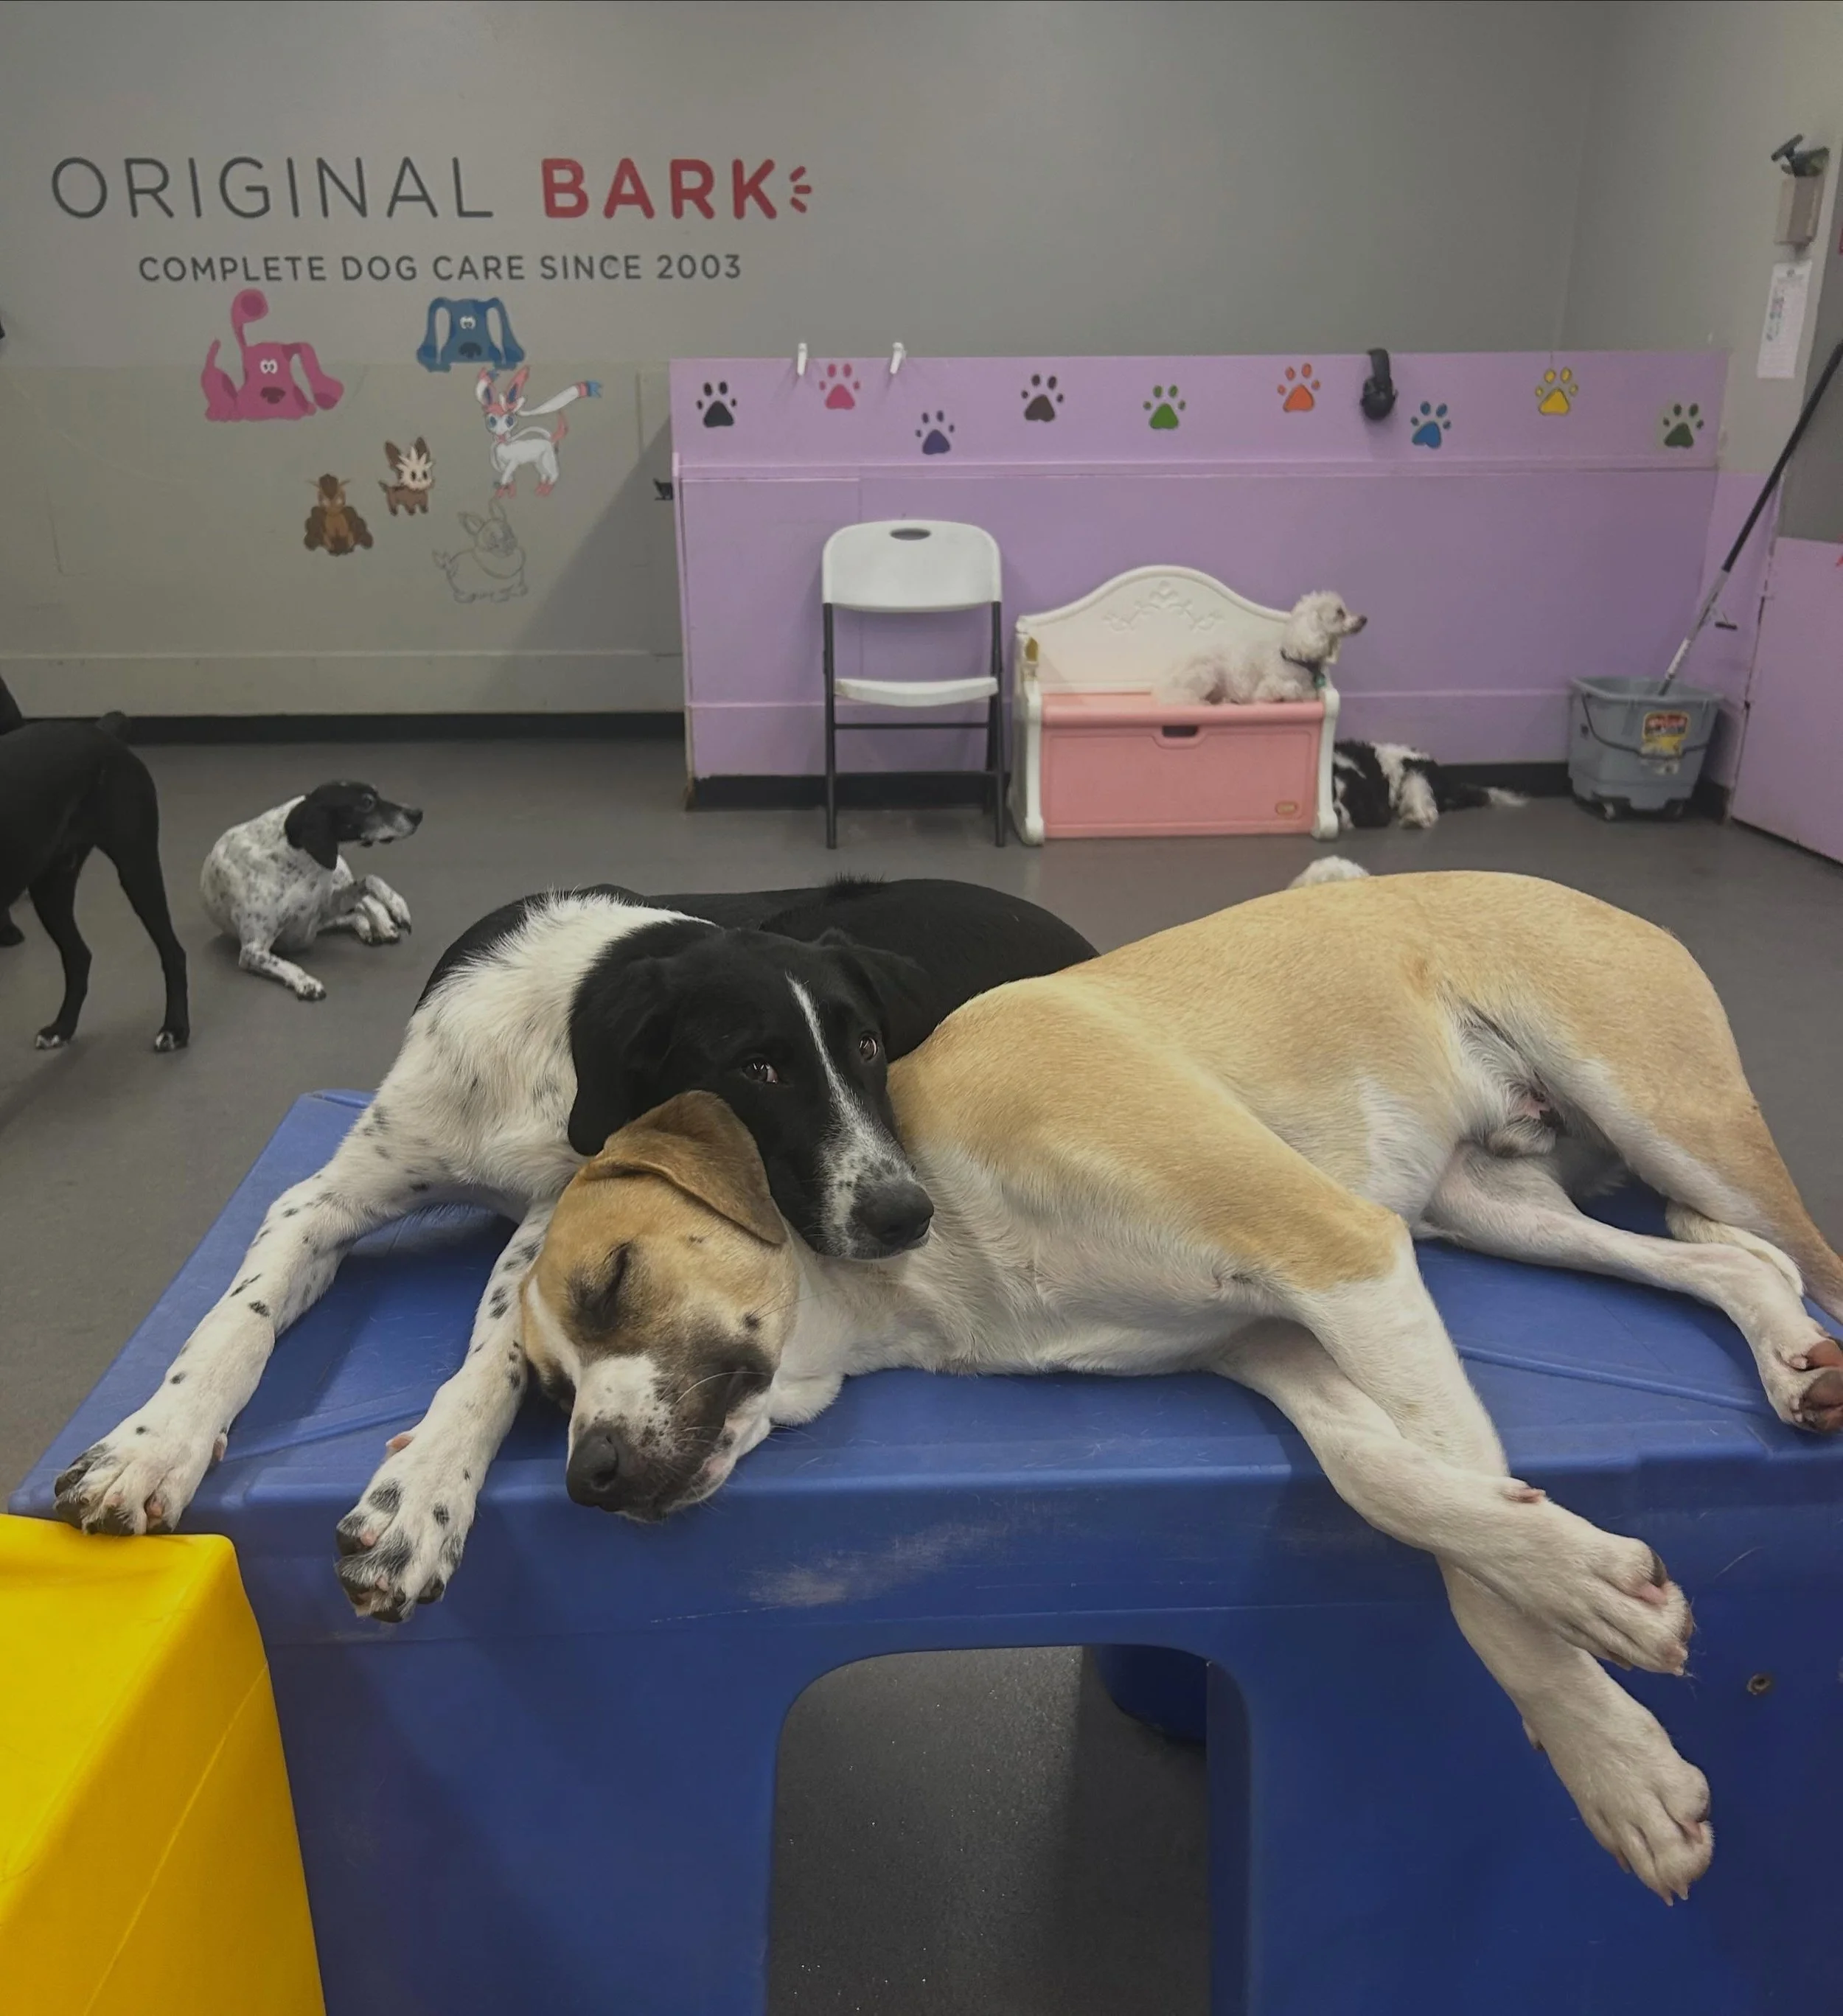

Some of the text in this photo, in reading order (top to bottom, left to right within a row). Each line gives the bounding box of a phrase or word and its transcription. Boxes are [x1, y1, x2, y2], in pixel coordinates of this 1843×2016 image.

[51, 156, 778, 220] ORIGINAL BARK
[139, 253, 742, 282] COMPLETE DOG CARE SINCE 2003
